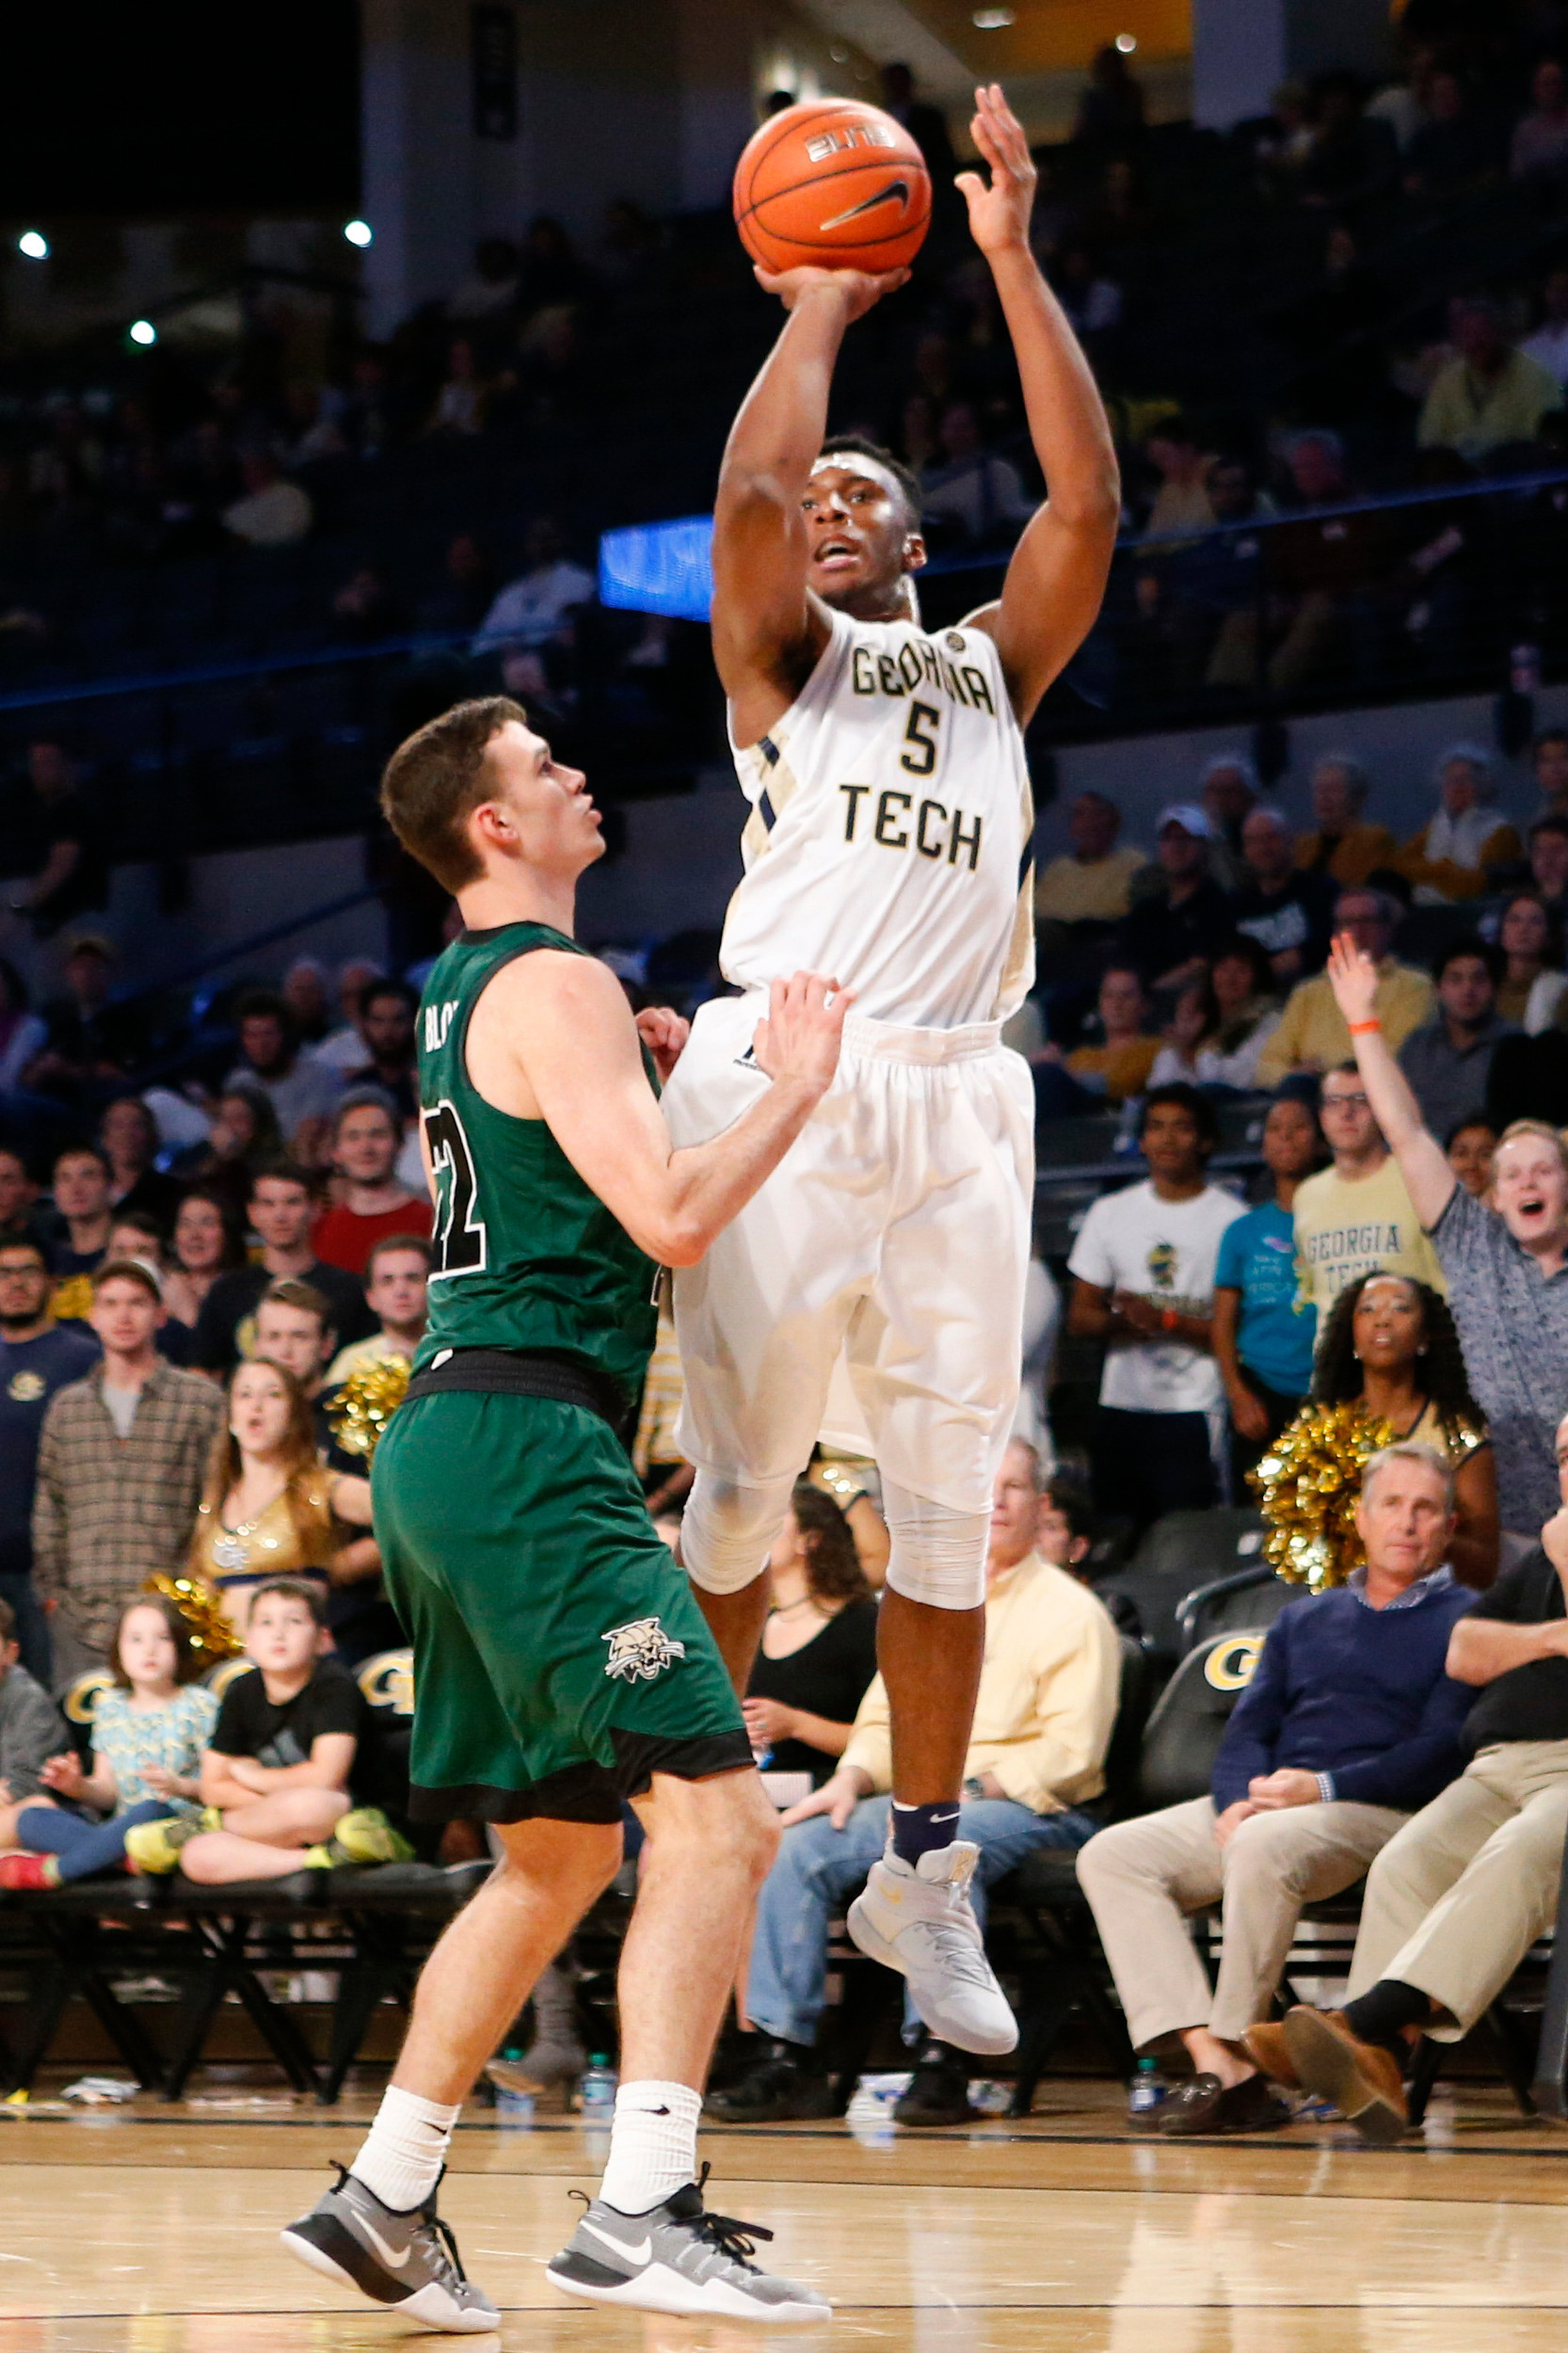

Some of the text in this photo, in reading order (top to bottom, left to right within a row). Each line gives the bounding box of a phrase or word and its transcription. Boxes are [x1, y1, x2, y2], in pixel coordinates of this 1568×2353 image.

[853, 637, 996, 716] GEORIA
[900, 699, 940, 776] 5
[839, 784, 983, 872] TECH
[424, 1000, 460, 1053] BLO
[423, 1098, 487, 1286] 2
[1306, 1225, 1401, 1264] GEORGIA
